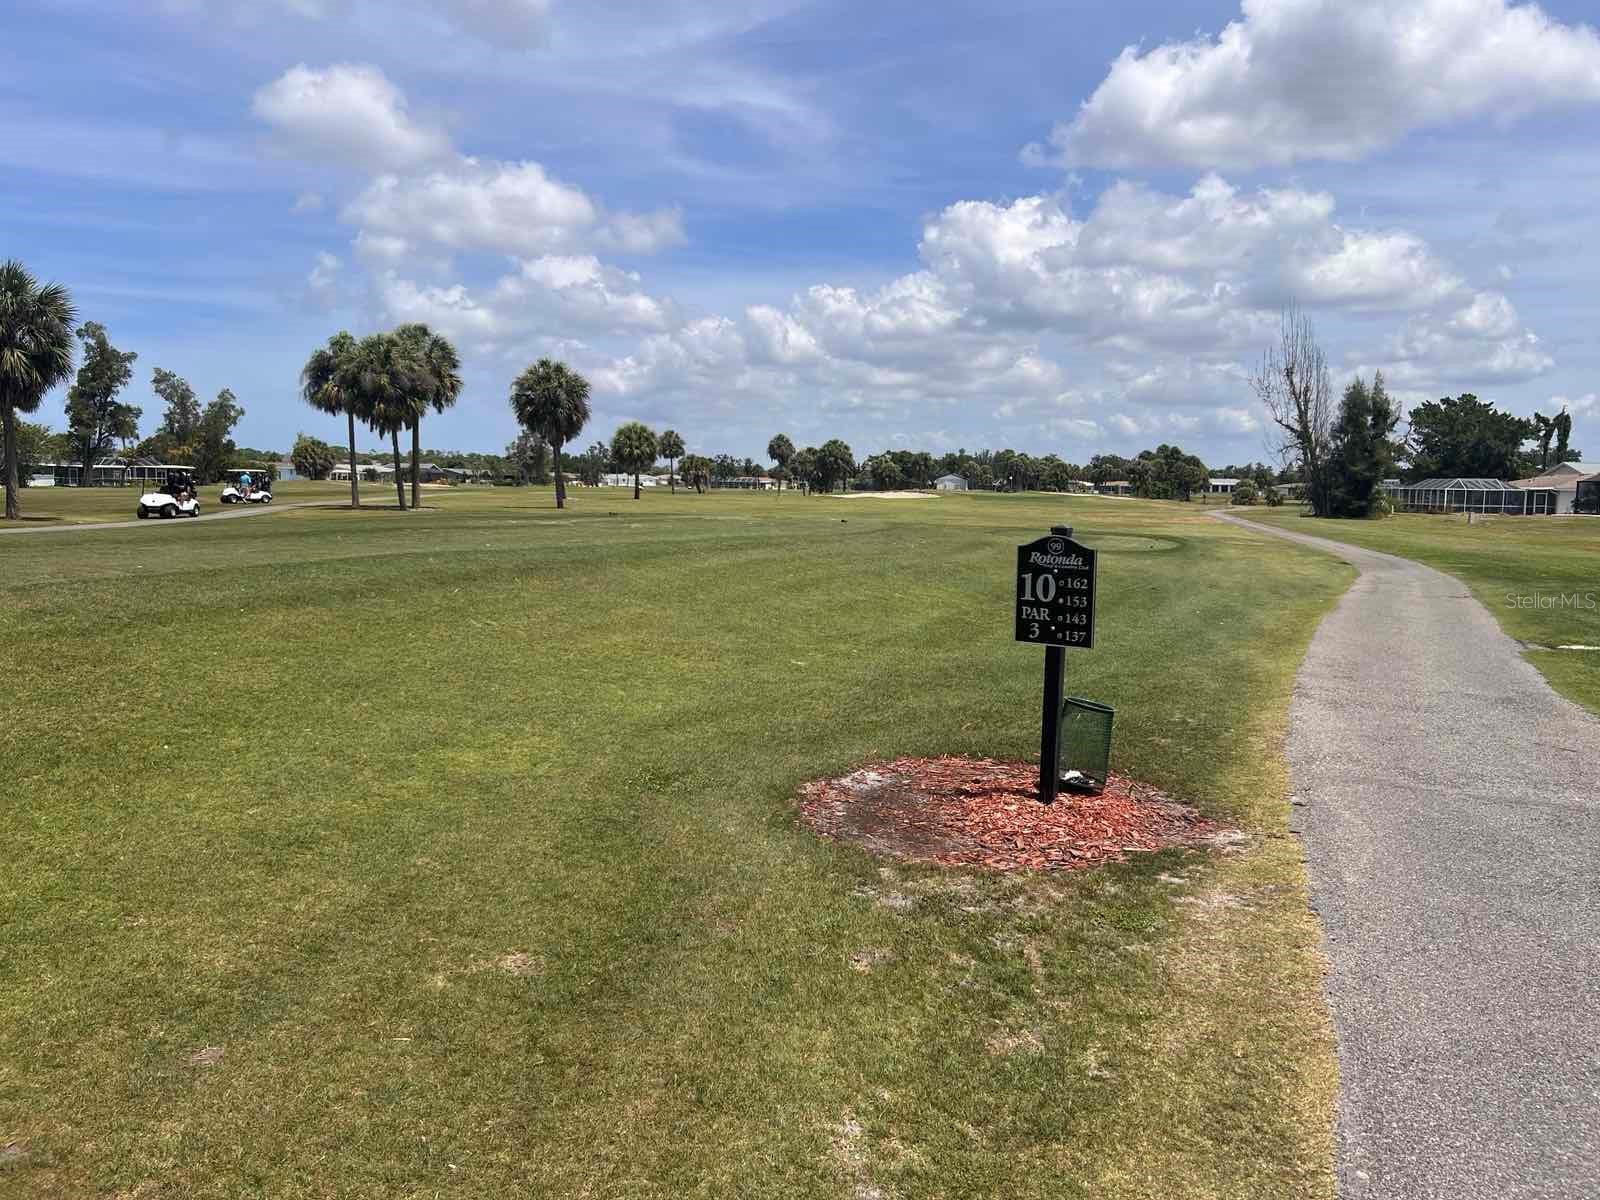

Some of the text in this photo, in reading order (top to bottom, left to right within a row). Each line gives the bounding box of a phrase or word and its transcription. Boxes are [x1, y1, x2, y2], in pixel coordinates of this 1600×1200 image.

[1029, 552, 1083, 565] Rotonda
[1020, 573, 1056, 602] 10
[1067, 578, 1088, 589] 162
[1066, 595, 1087, 608] 153
[1021, 606, 1050, 621] PAR
[1065, 613, 1087, 625] 143
[1029, 622, 1040, 638] 3
[1065, 631, 1086, 642] 137
